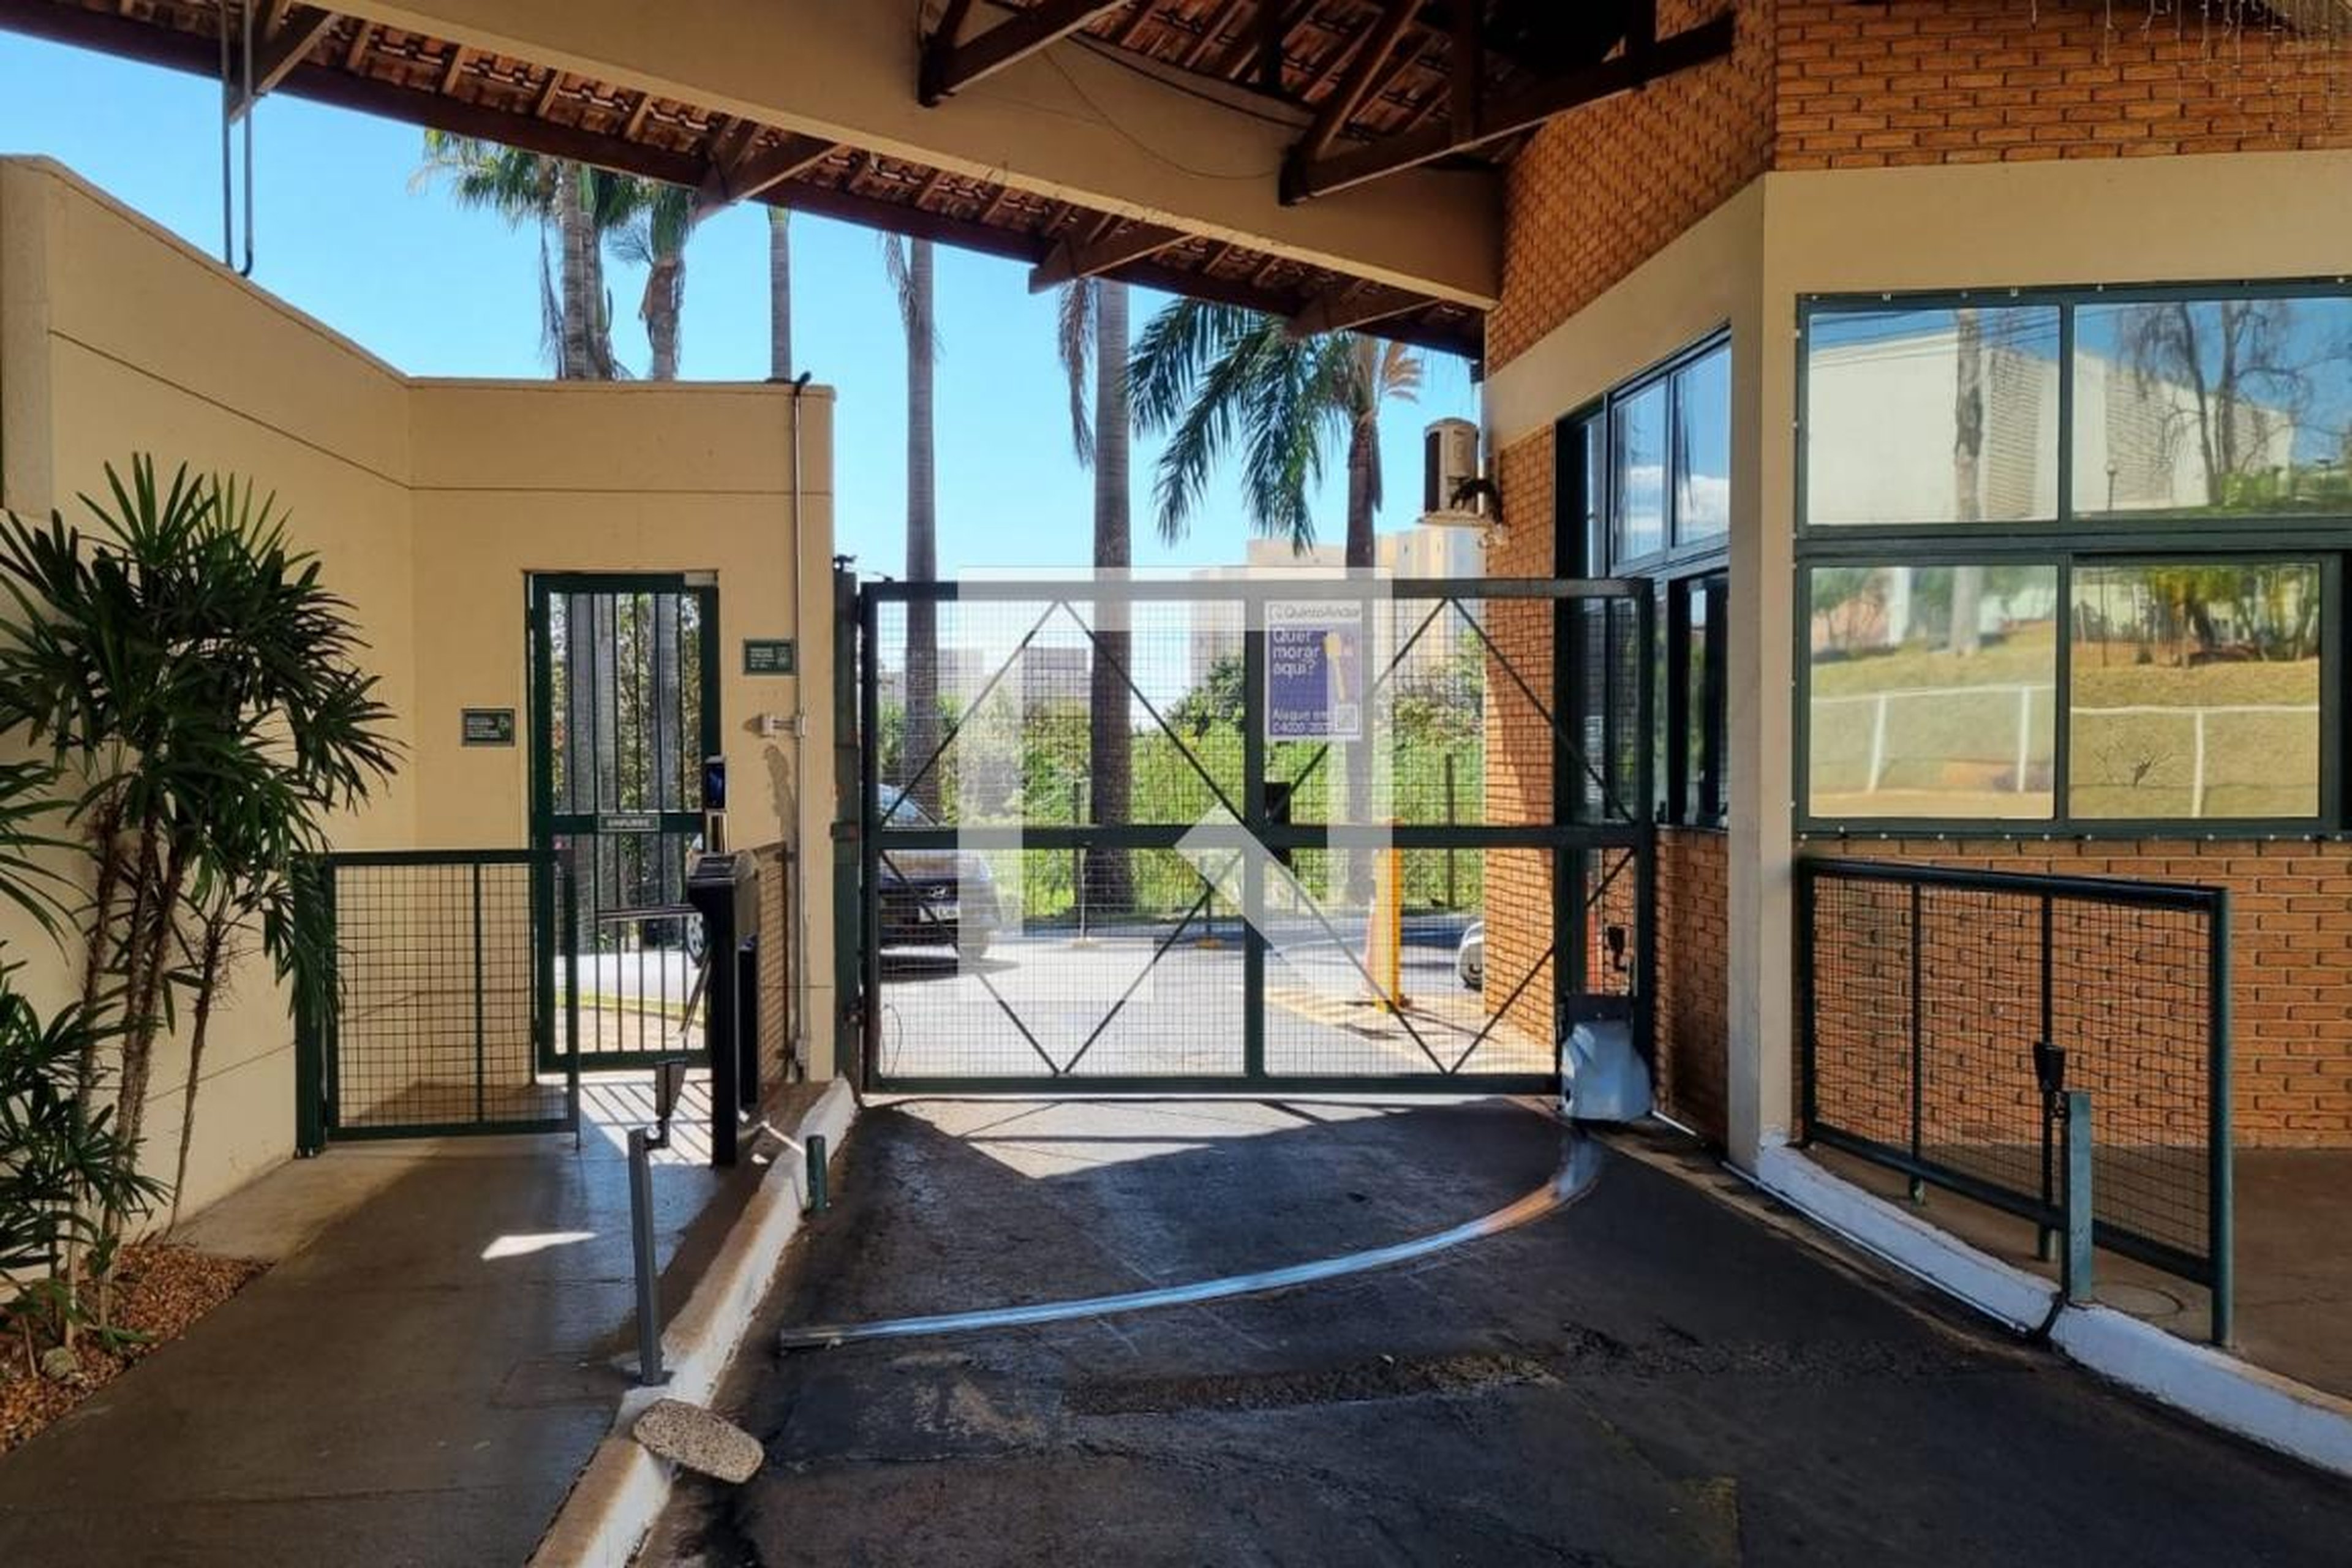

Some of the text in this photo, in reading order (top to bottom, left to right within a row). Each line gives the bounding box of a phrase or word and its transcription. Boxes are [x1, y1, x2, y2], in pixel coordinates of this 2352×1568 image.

[1273, 628, 1311, 643] Quer
[1273, 645, 1321, 658] morar
[1273, 661, 1316, 677] aqui?
